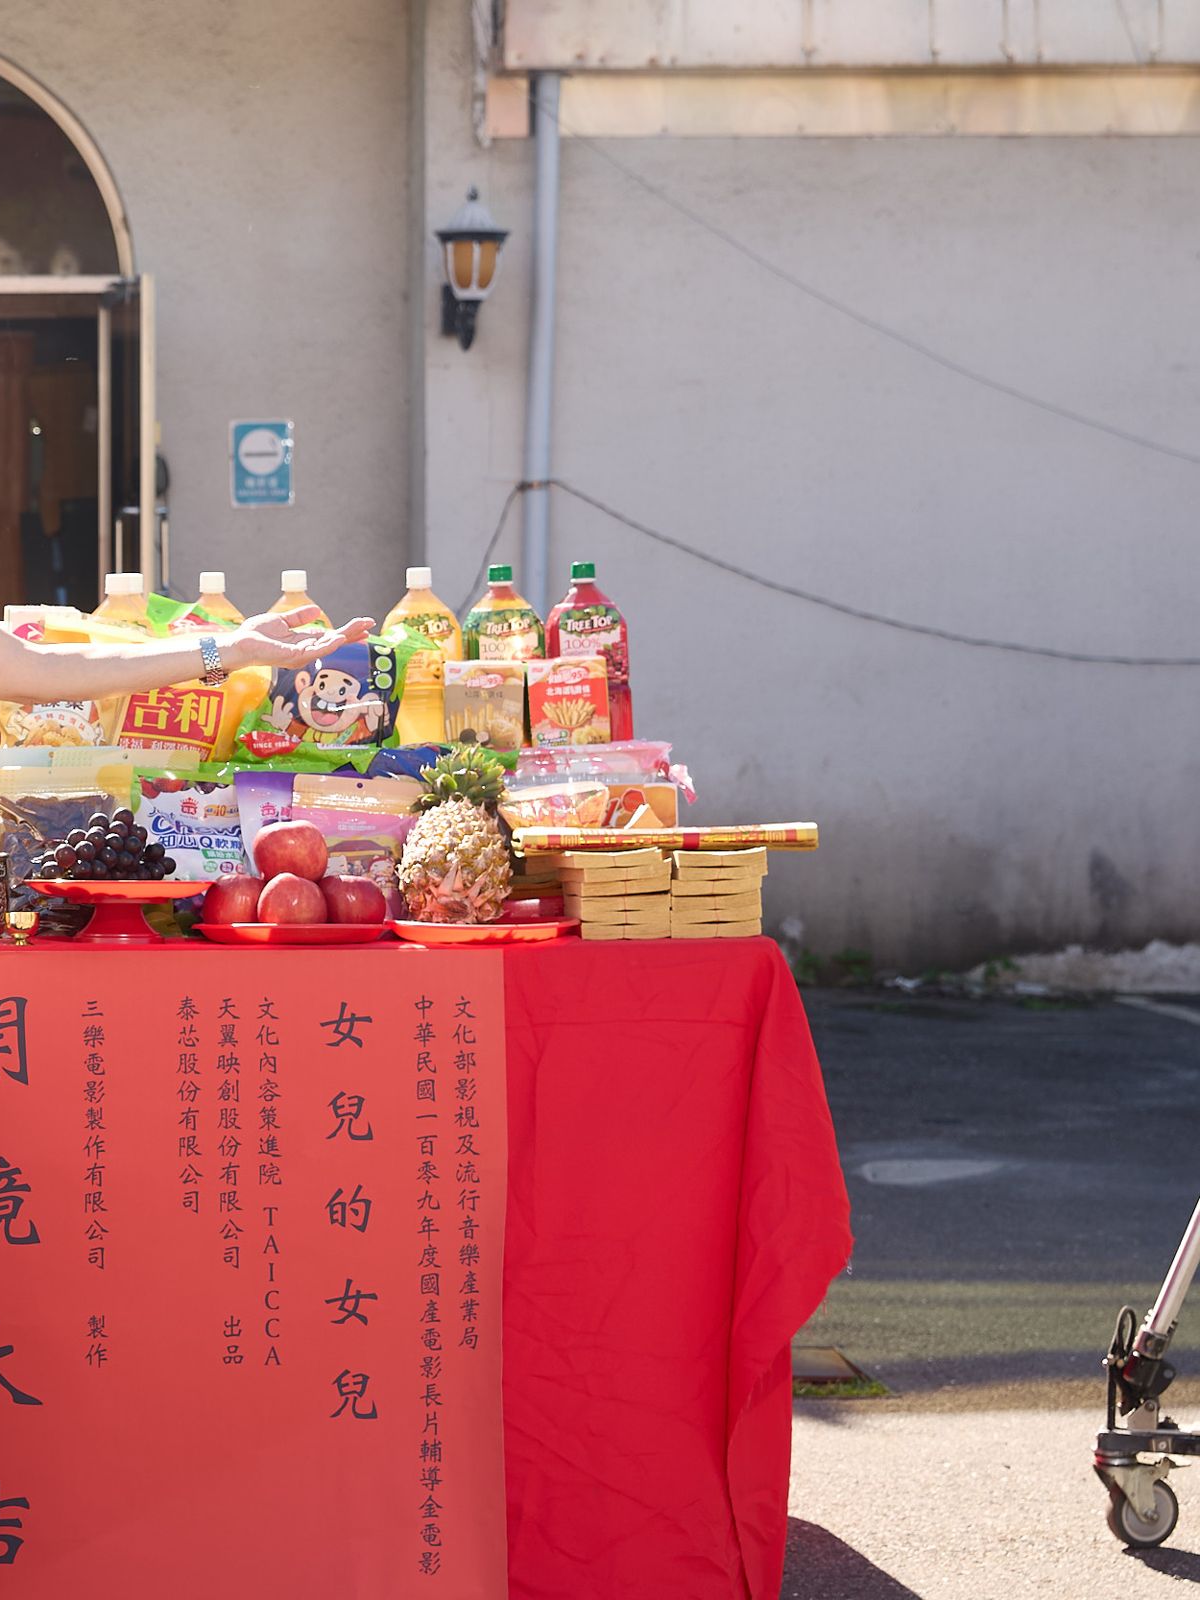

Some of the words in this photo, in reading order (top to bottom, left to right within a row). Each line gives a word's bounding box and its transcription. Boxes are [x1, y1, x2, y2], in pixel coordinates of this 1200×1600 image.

[133, 688, 221, 737] 吉利
[482, 642, 509, 653] 100
[81, 1000, 108, 1270] 三樂電影製作有限公司
[175, 995, 204, 1215] 泰芯股份有限公司
[216, 997, 244, 1269] 天翼映創股份有限公司
[255, 996, 282, 1185] 文化內容策進院
[452, 995, 481, 1350] 文化部影視及流行音樂產業局
[262, 1206, 281, 1366] TAICCA
[319, 1001, 379, 1420] 女兒的女兒
[413, 994, 443, 1576] 中華民國一百零九年度國產電影長片輔導金電影
[85, 1314, 108, 1368] 製作
[222, 1315, 244, 1365] 出品
